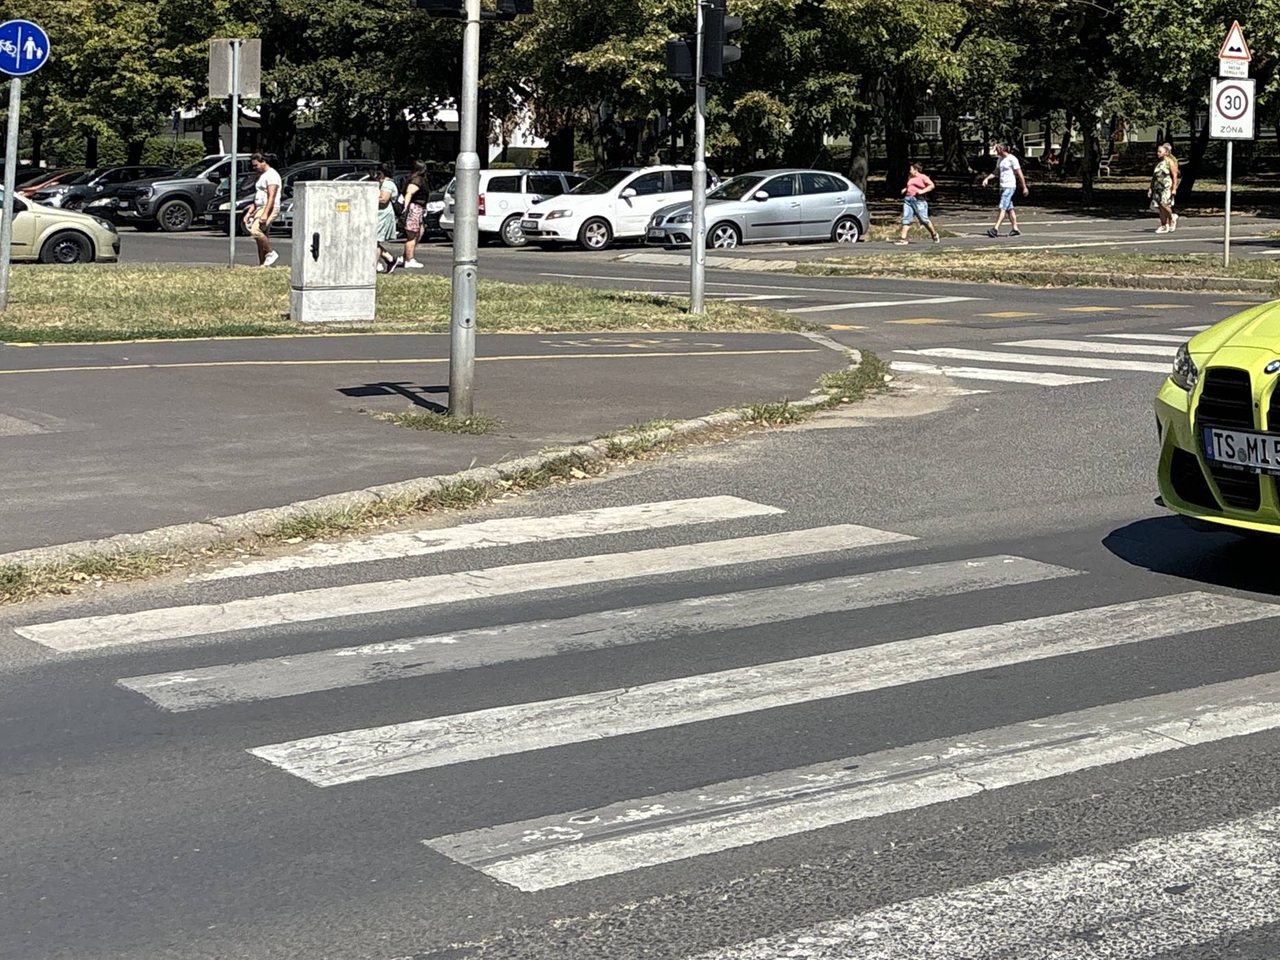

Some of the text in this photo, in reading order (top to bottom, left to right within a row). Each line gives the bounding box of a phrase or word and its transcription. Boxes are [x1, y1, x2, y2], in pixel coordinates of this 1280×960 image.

[1224, 95, 1242, 111] 30
[1220, 125, 1244, 134] ZÓNA
[1213, 432, 1236, 459] TS
[1246, 437, 1271, 465] MI
